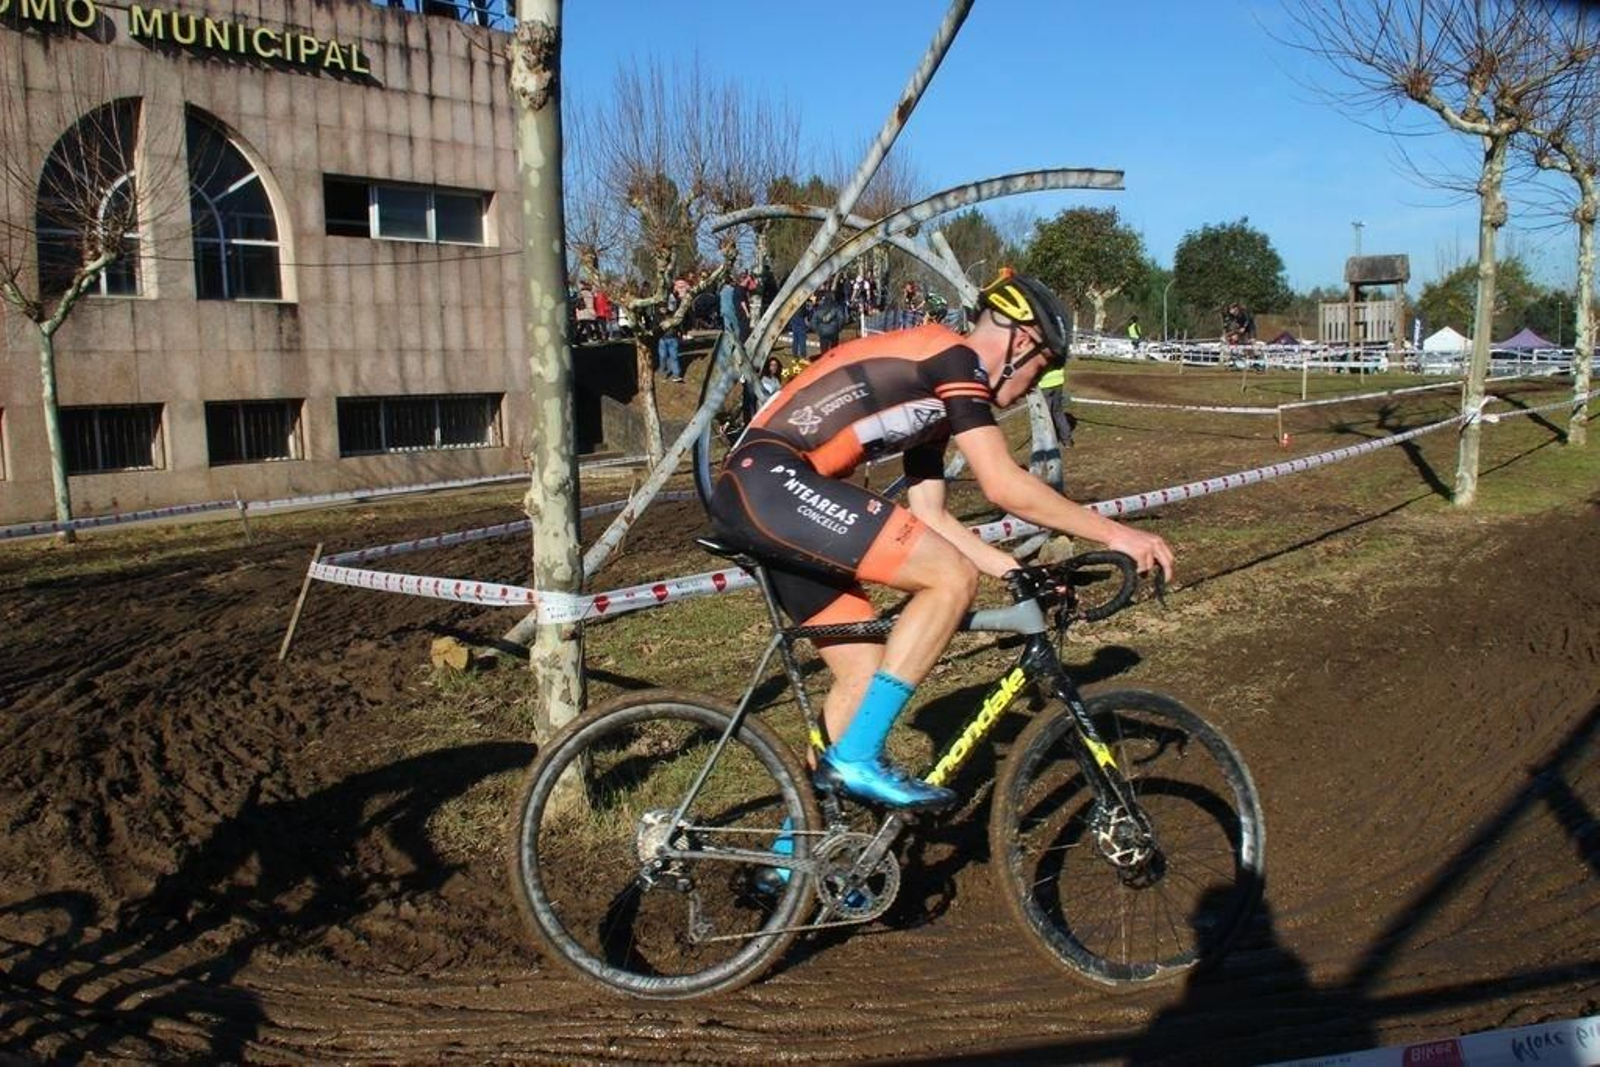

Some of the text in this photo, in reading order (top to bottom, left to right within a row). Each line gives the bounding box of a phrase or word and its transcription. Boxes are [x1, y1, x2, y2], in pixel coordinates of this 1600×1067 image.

[0, 0, 370, 75] MO MUNICIPAL
[797, 505, 848, 534] CONCELLO
